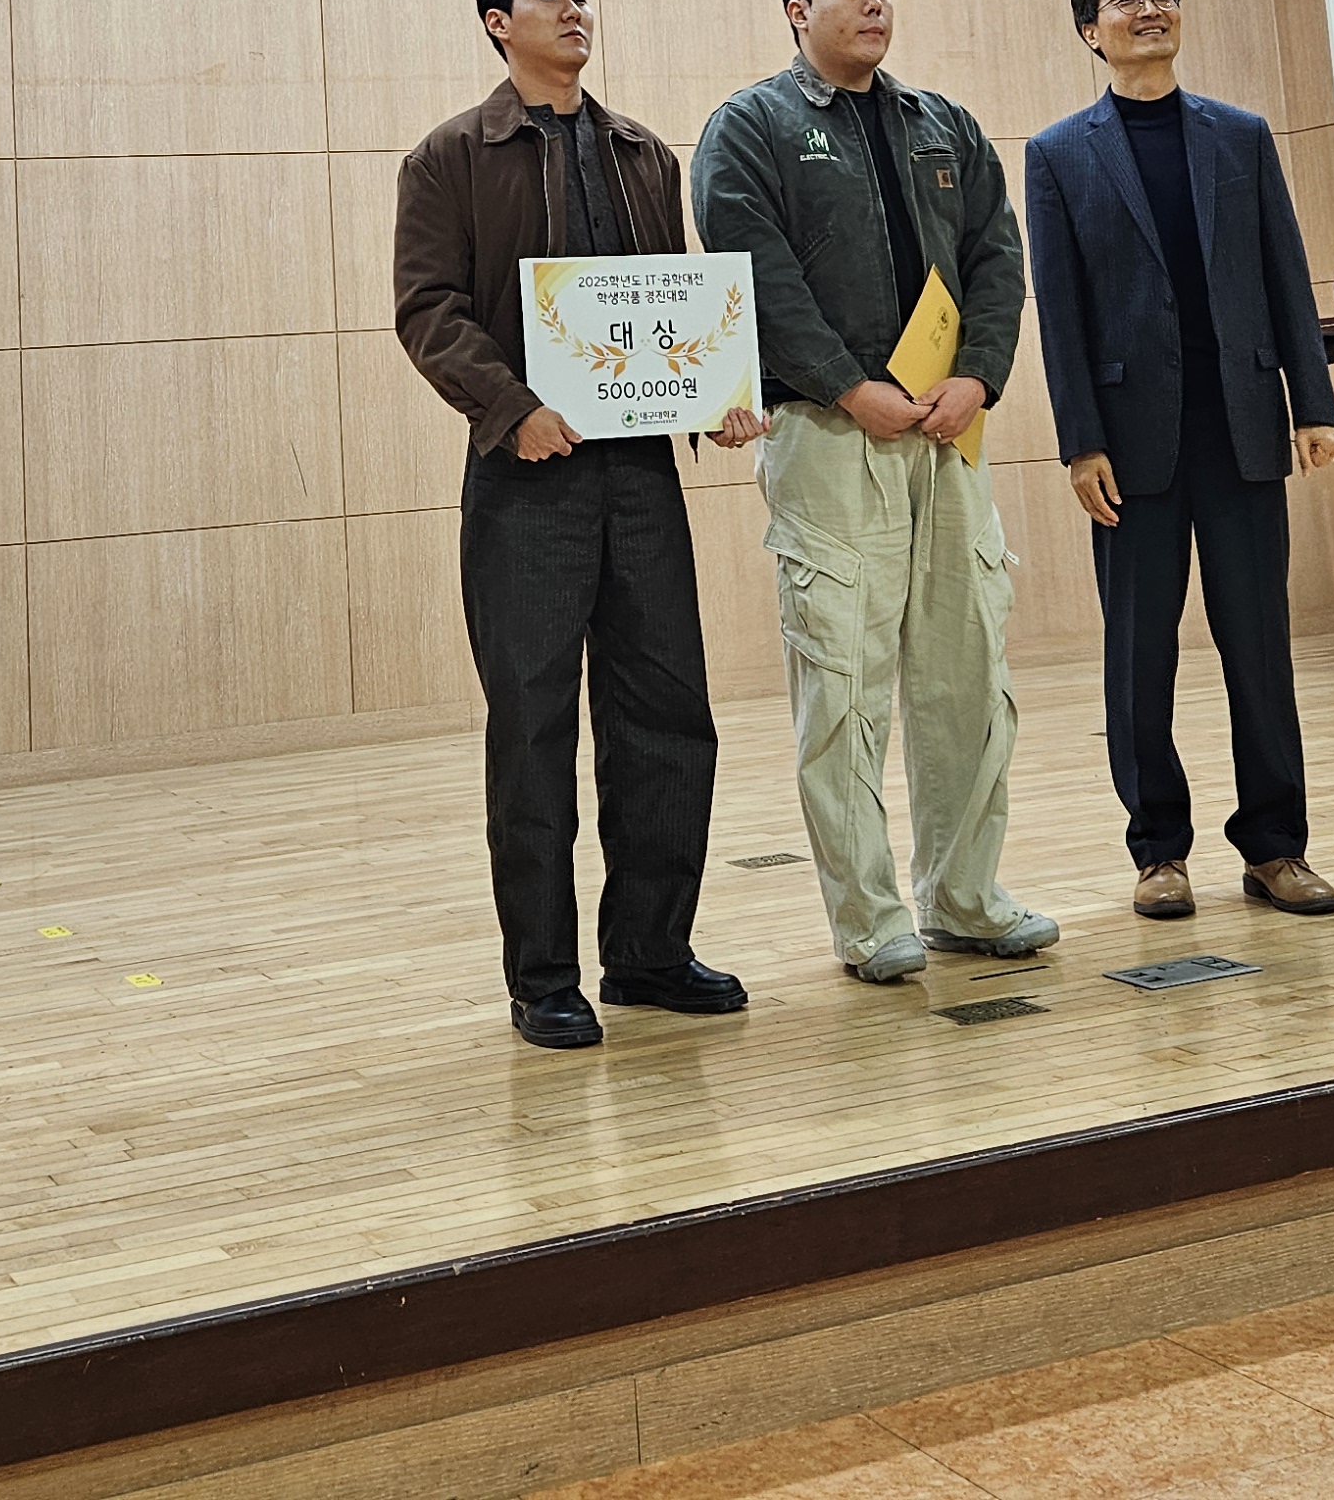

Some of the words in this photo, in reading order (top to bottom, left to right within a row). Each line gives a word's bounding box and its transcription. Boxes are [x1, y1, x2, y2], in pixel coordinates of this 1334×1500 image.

[578, 275, 642, 288] 2025학년도
[597, 290, 640, 305] 학생작품
[645, 289, 688, 303] 경진대회
[597, 377, 698, 402] 500,000원
[639, 410, 678, 420] 대구대학교
